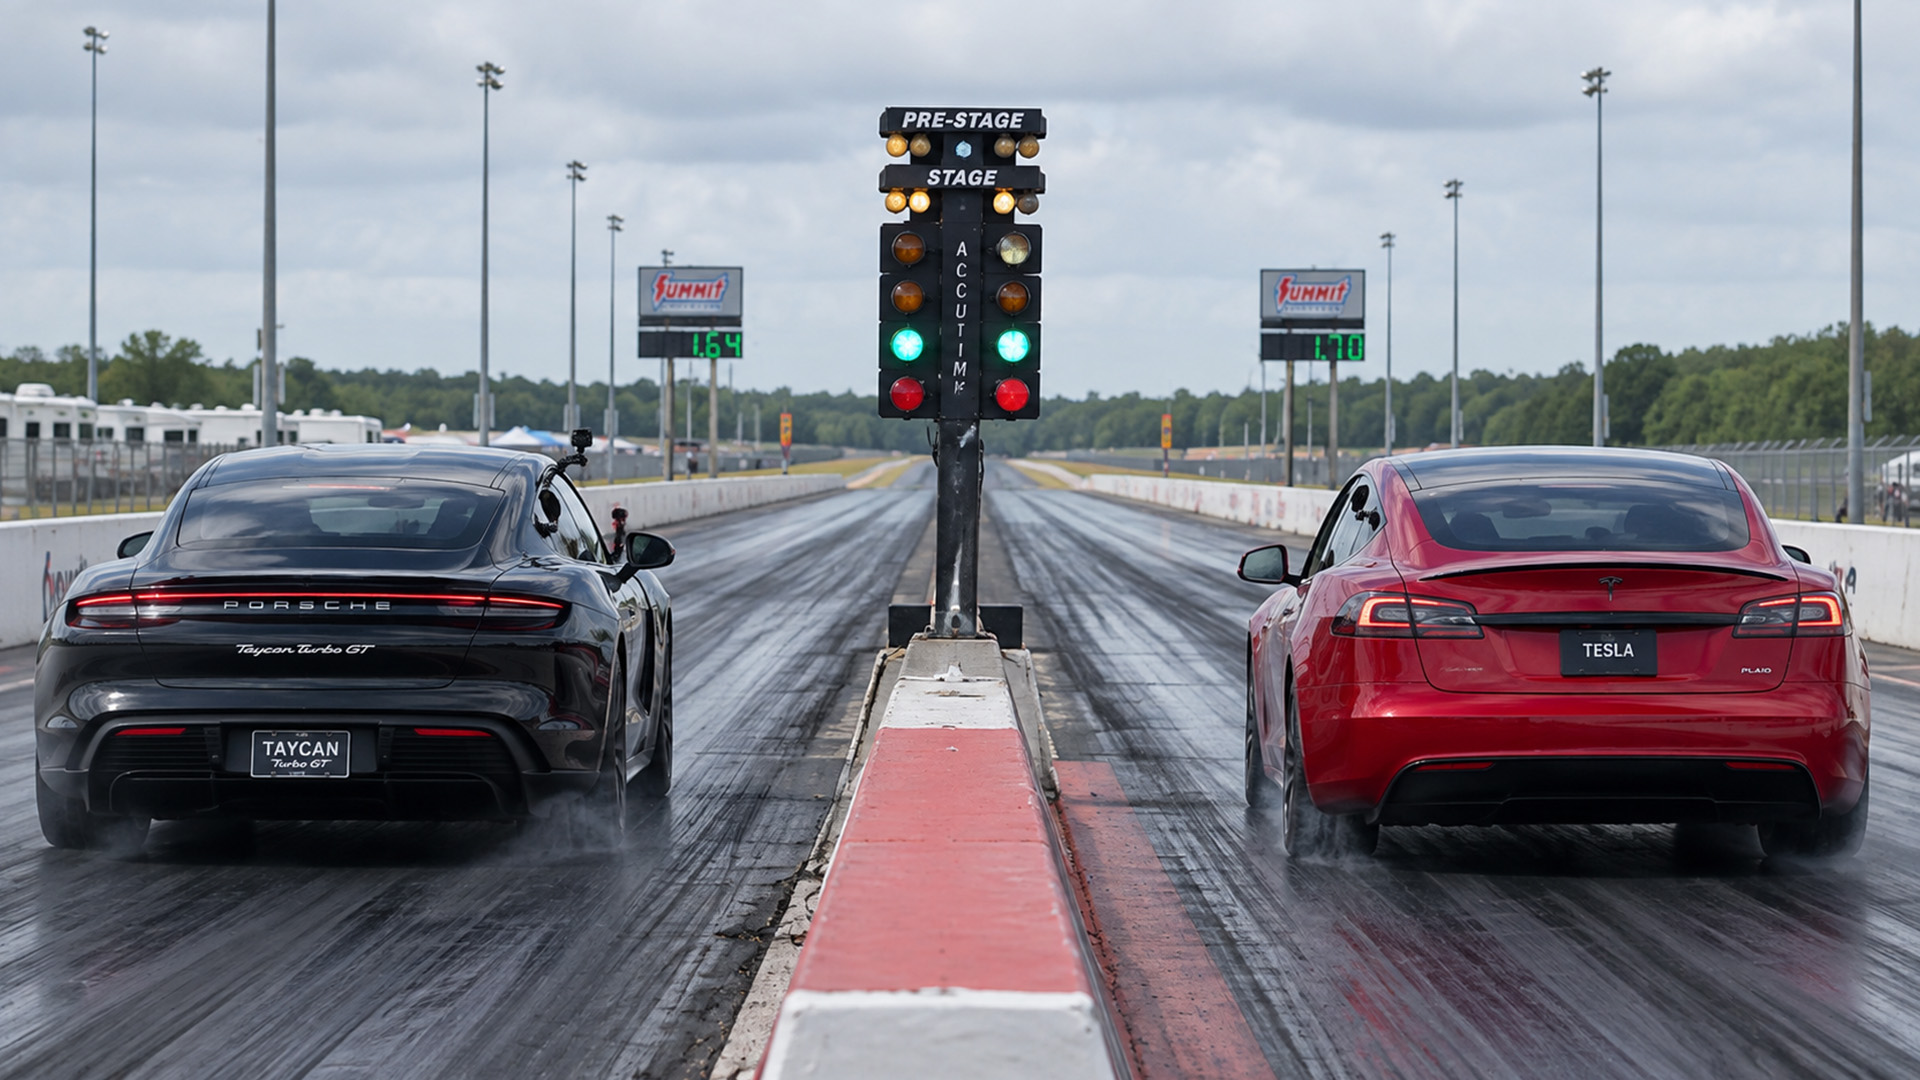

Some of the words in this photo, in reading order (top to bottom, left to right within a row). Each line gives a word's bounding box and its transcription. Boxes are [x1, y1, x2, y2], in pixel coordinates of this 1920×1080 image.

[902, 111, 1024, 128] PRE-STAGE
[927, 169, 997, 186] STAGE
[653, 271, 727, 307] SUMMIT
[1276, 275, 1349, 309] SUMMIT
[693, 330, 741, 358] 1.64
[1315, 333, 1363, 360] 1.70
[223, 601, 391, 610] PORSCHE
[236, 644, 295, 657] Taycan
[297, 644, 342, 654] Turbo
[345, 644, 375, 654] GT
[1582, 643, 1634, 658] TESLA
[262, 741, 339, 756] TAYCAN
[270, 759, 308, 768] Turbo
[310, 759, 333, 768] GT
